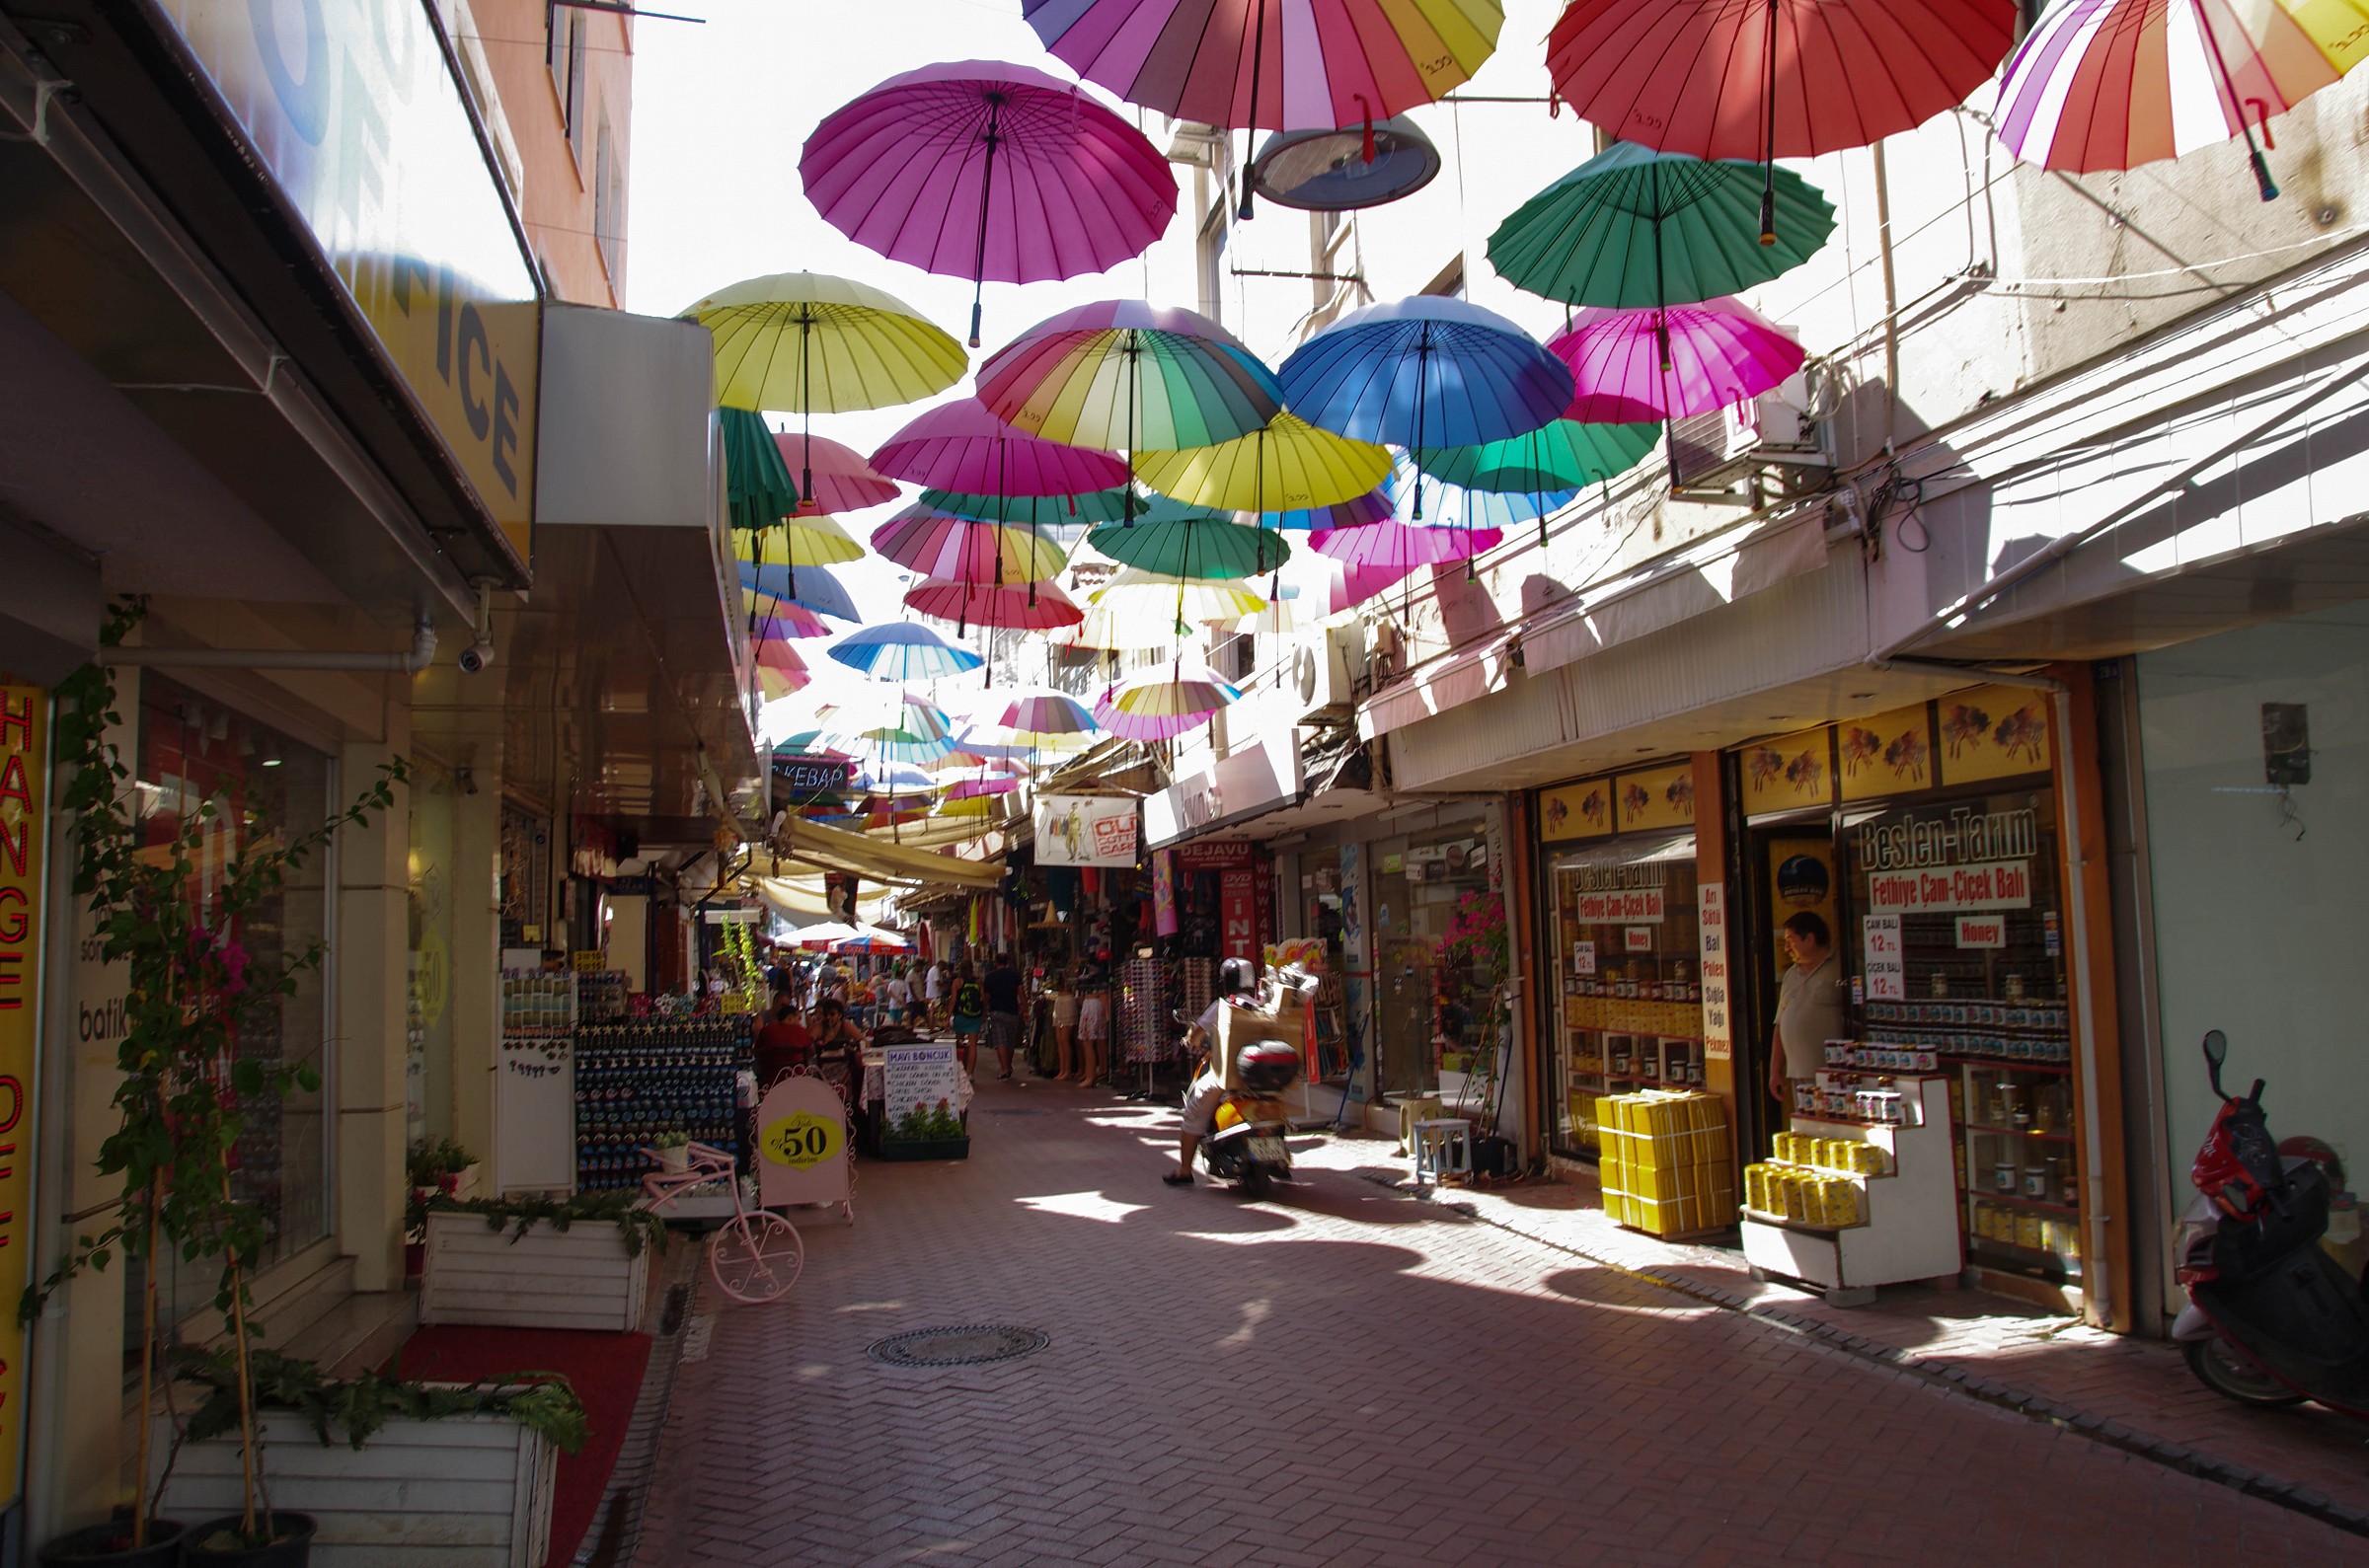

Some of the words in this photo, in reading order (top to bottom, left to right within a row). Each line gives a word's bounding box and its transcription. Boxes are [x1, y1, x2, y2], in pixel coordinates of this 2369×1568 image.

[1860, 807, 2037, 871] Beslen-Tarım
[1181, 844, 1249, 857] DEJAVU
[1872, 874, 1918, 909] Fethiye
[1920, 868, 1993, 908] Çam-Çiçek
[1996, 866, 2025, 900] Balı
[1705, 888, 1717, 905] Arı
[1579, 895, 1605, 920] Fethiye
[1702, 909, 1721, 926] Sütü
[1866, 919, 1881, 932] ÇAM
[1881, 918, 1898, 930] BALI
[1628, 932, 1649, 948] Honey
[1961, 921, 2001, 945] Honey
[1706, 935, 1719, 951] Bal
[1871, 935, 1884, 952] 12
[1886, 942, 1897, 951] TL
[1577, 955, 1586, 968] 12
[1703, 960, 1724, 977] Polen
[1886, 962, 1901, 974] BALI
[1873, 978, 1886, 996] 12
[1888, 986, 1899, 995] TL
[79, 999, 127, 1042] batik
[1706, 1035, 1730, 1053] Pekmez
[913, 1050, 951, 1061] BONCUK
